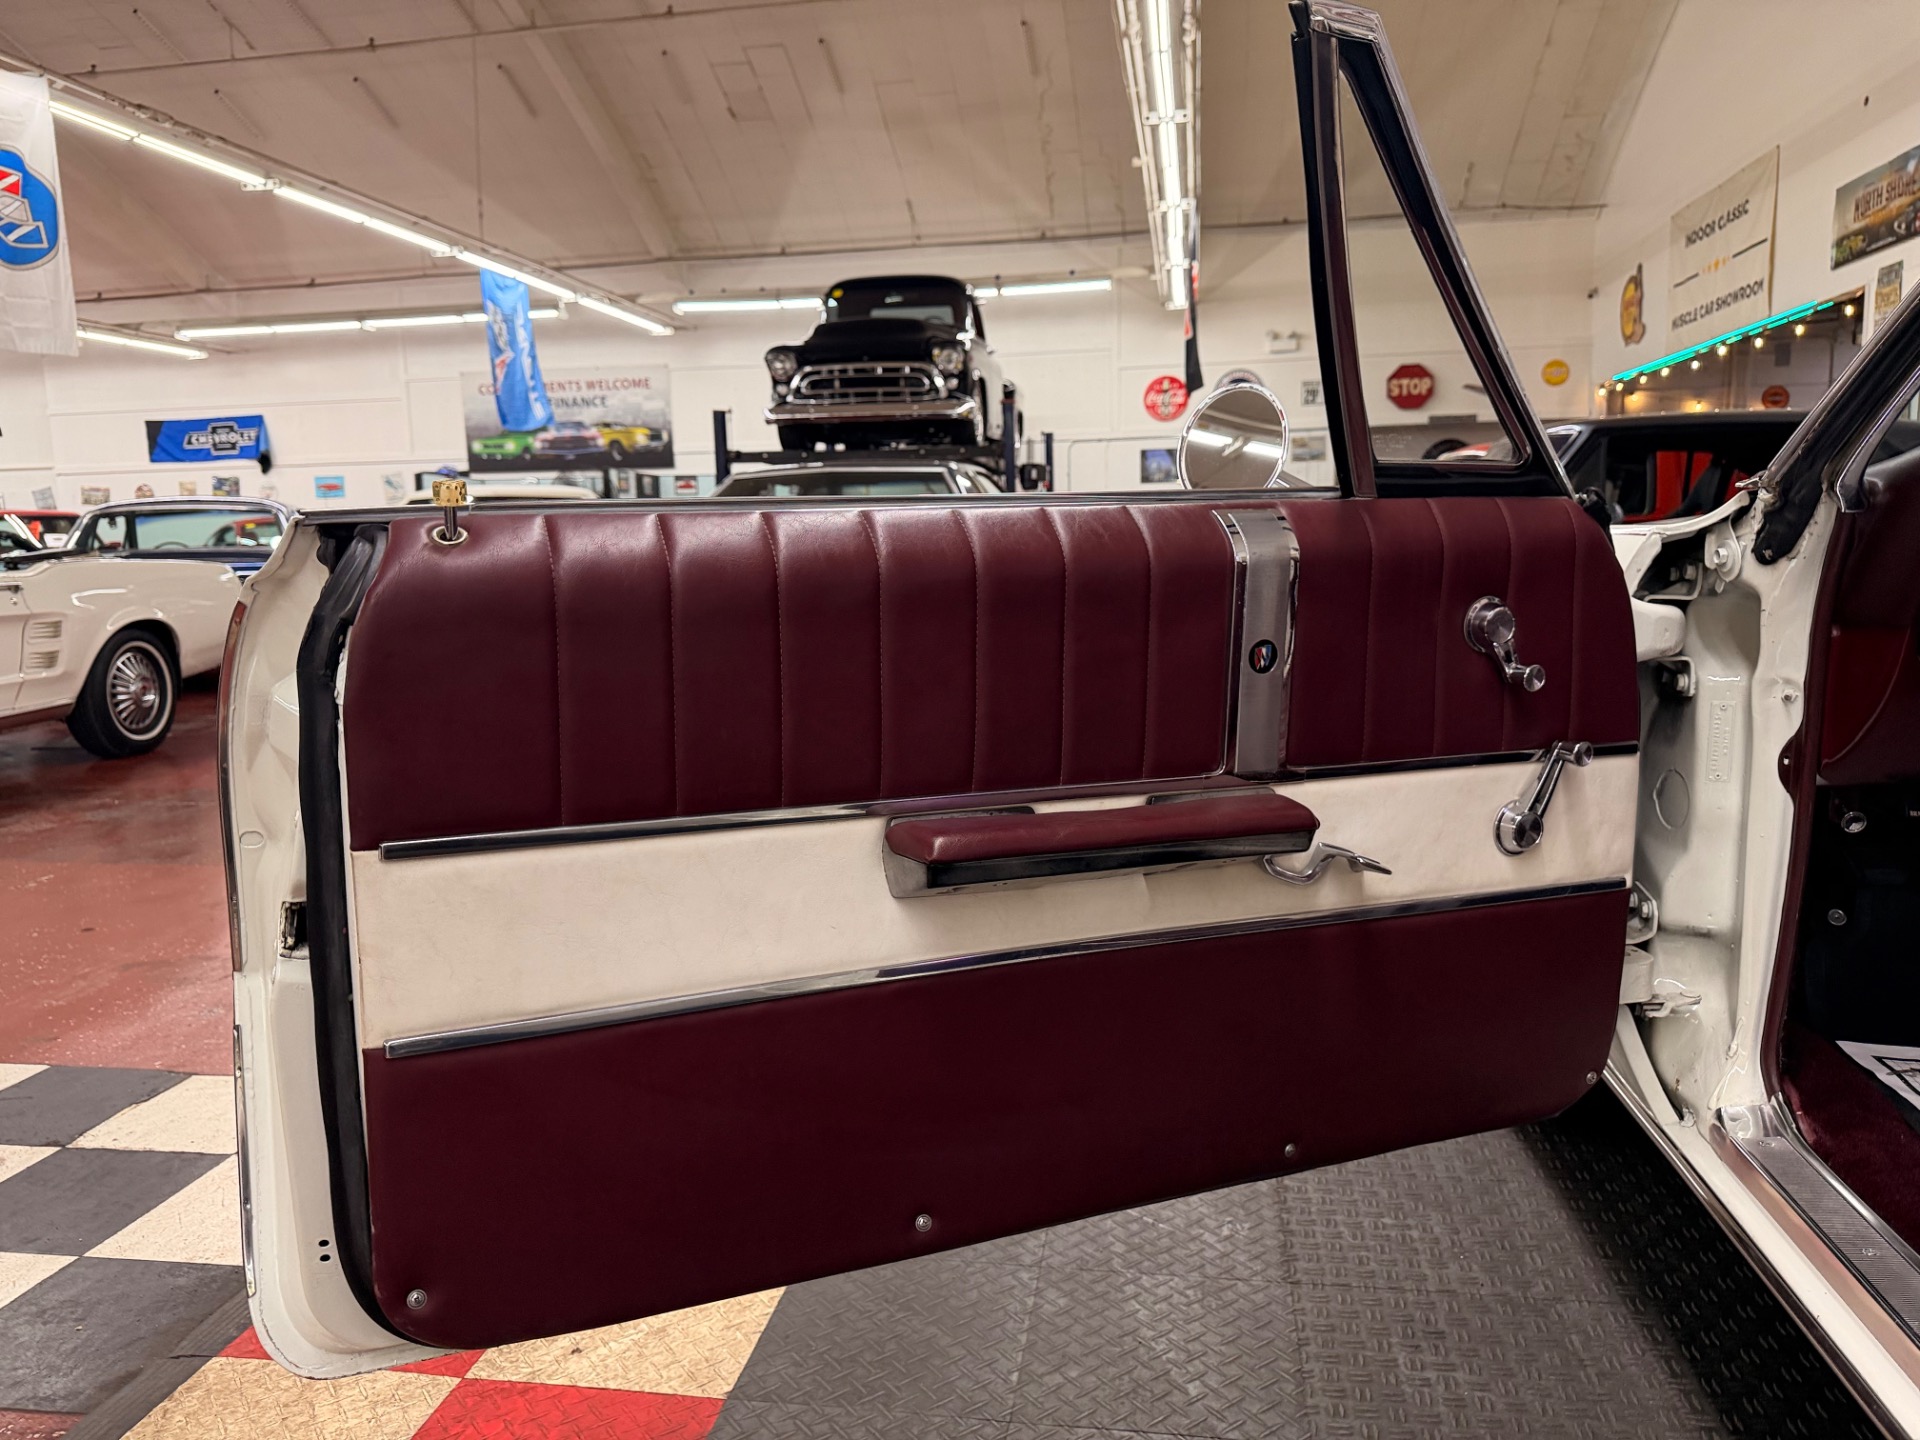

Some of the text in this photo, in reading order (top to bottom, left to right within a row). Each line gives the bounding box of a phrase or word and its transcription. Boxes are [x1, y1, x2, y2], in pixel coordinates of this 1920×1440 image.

[1853, 185, 1883, 223] NORTH
[1685, 198, 1750, 248] INDOOR CLASSIC
[1700, 300, 1714, 319] CAR
[1715, 276, 1765, 312] SHOWROOM
[585, 376, 651, 391] WELCOME
[1389, 376, 1433, 397] STOP
[191, 431, 257, 446] CHEVROLET
